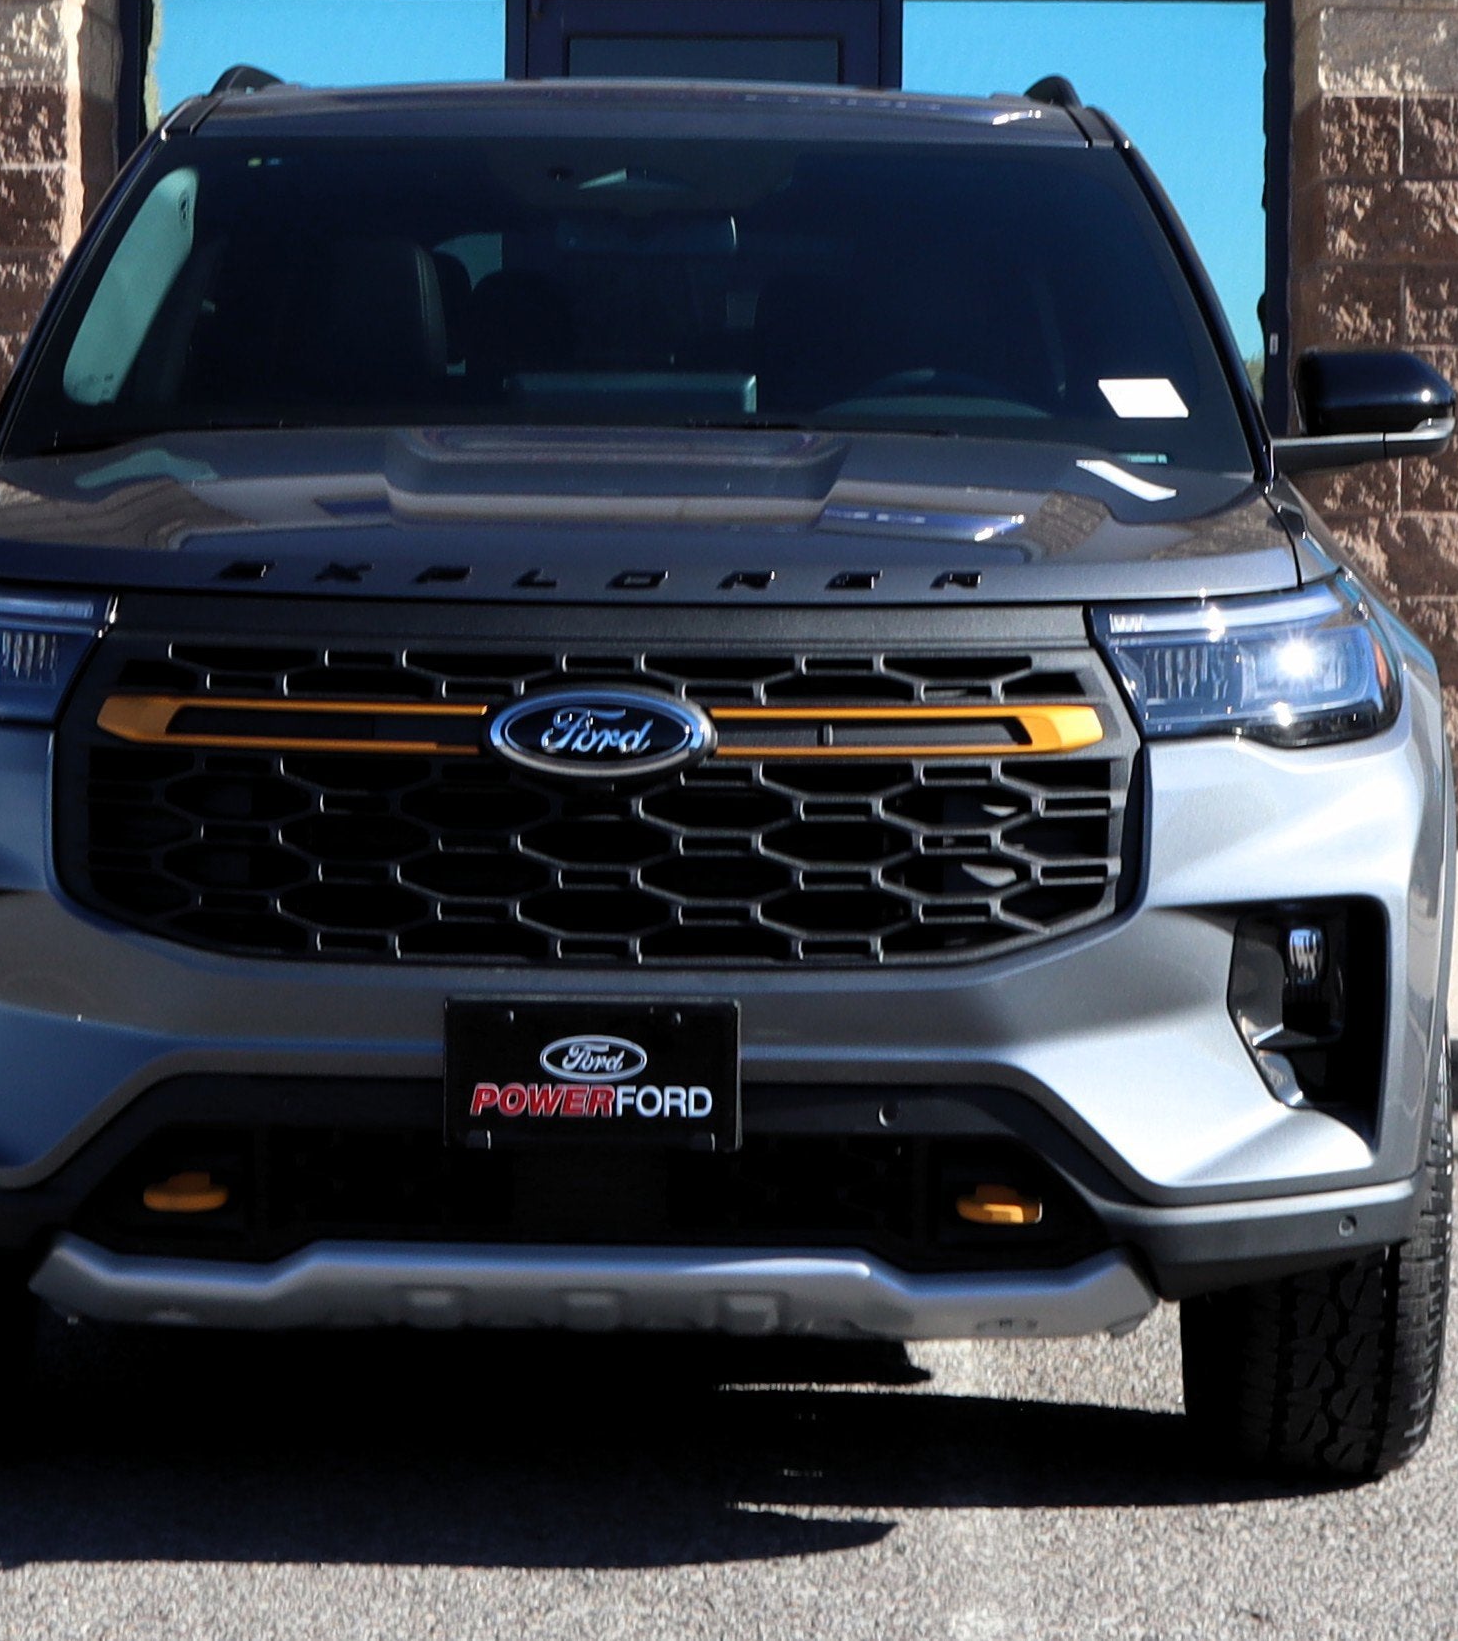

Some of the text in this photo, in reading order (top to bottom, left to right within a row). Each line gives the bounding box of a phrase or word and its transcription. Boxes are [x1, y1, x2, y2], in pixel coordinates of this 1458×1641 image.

[541, 708, 654, 754] Ford
[561, 1043, 625, 1073] Ford
[469, 1082, 713, 1118] POWERFORD
